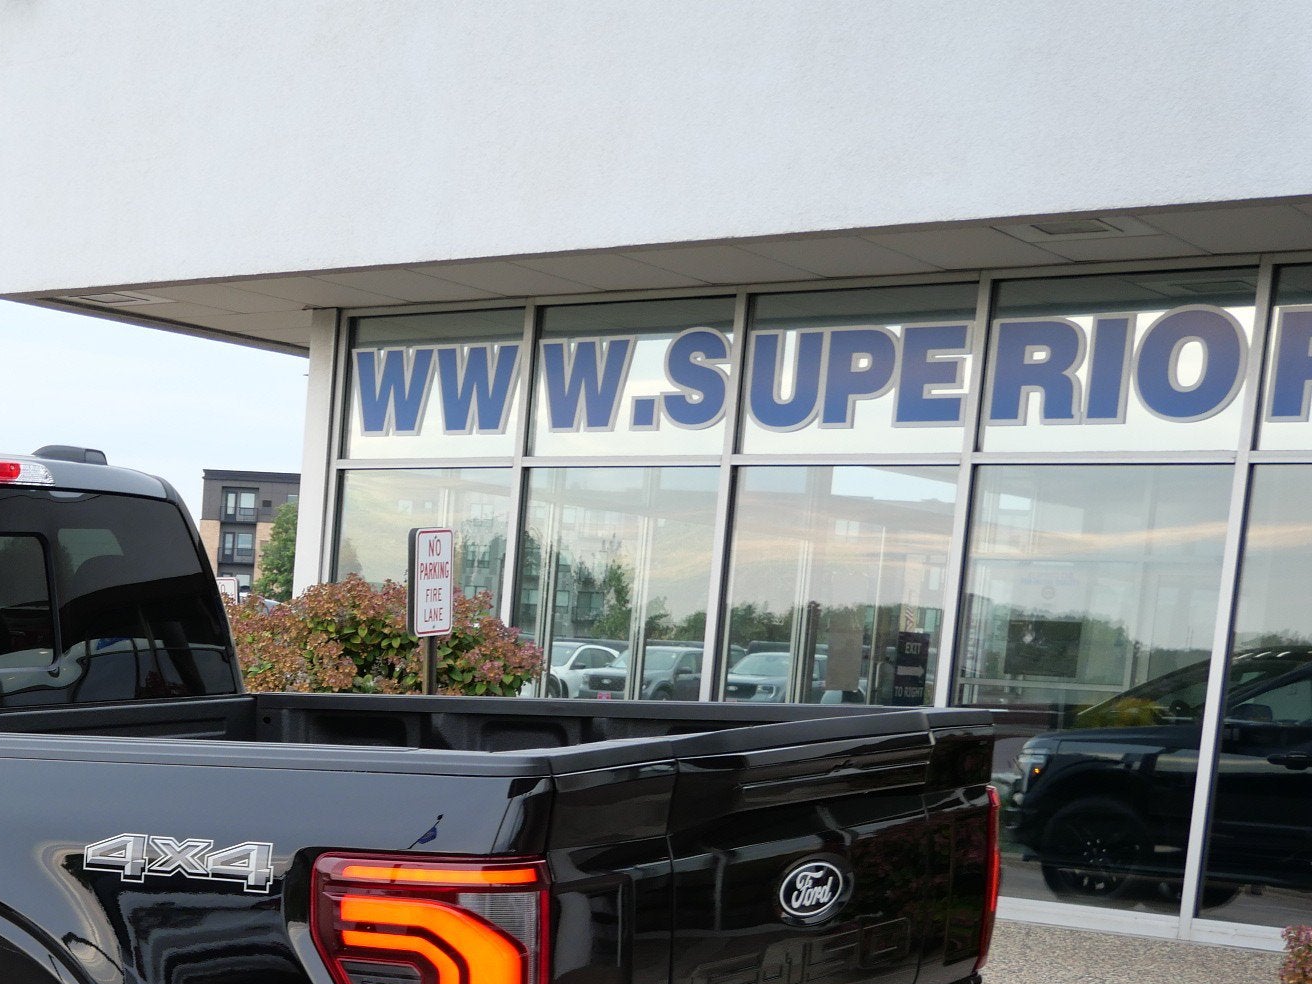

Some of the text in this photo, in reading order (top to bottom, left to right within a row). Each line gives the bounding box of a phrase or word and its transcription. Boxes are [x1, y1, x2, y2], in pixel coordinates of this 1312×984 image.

[428, 539, 442, 557] NO
[420, 561, 449, 580] PARKING
[425, 587, 443, 603] FIRE
[423, 607, 444, 622] LANE
[904, 642, 923, 655] EXIT
[894, 686, 903, 697] TO
[790, 869, 835, 909] Ford
